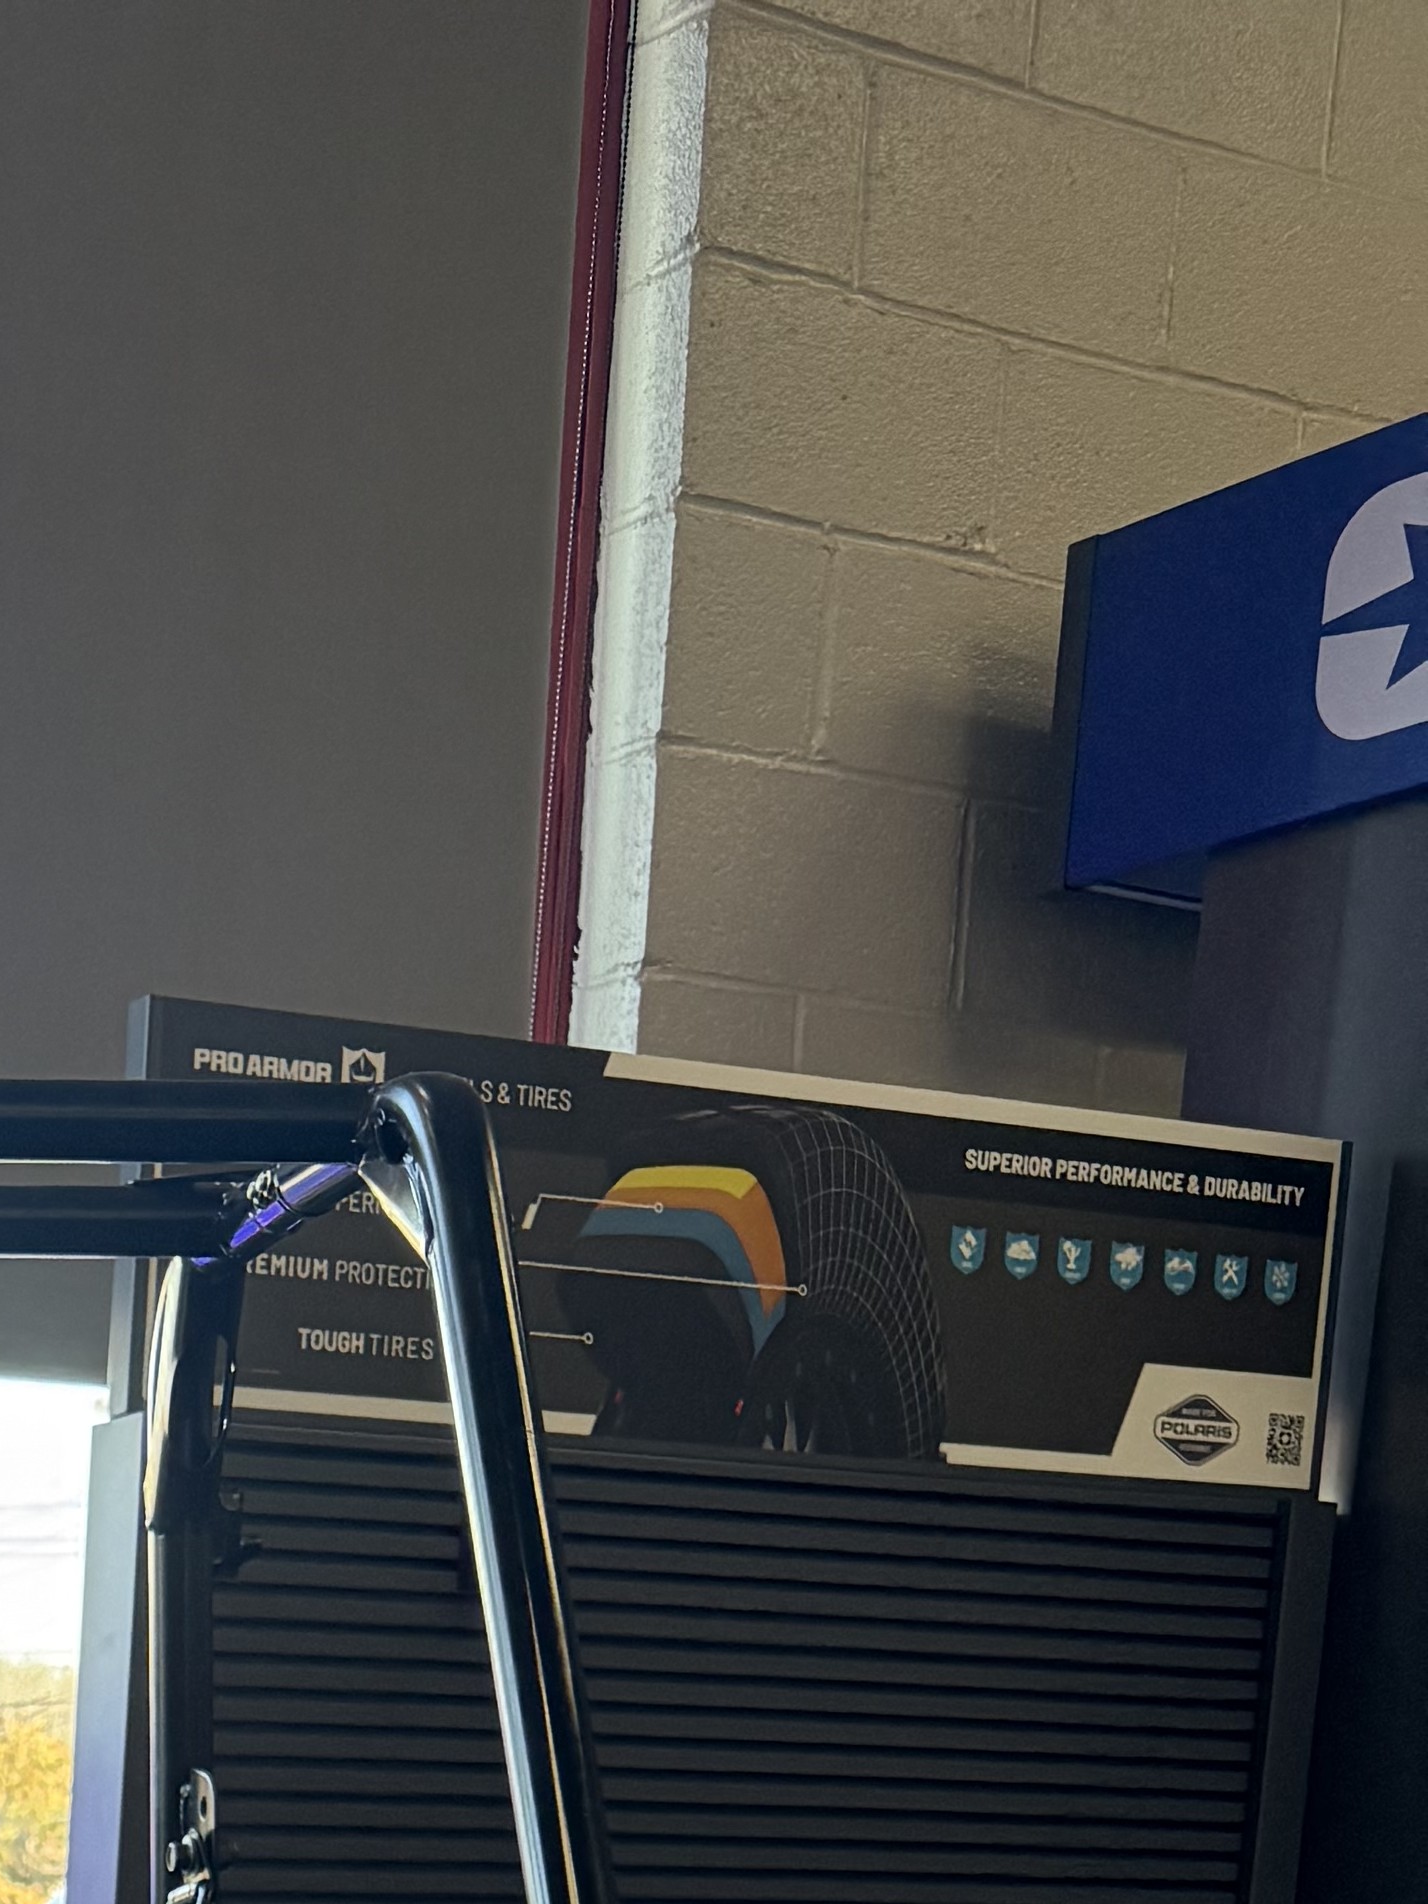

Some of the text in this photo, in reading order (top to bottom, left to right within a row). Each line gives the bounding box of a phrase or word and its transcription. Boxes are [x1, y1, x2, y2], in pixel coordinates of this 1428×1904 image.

[516, 1083, 573, 1113] TIRES
[963, 1148, 1306, 1207] SUPERIOR PERFORMANCE & DURABILITY
[246, 1253, 432, 1290] EMIUM PROTECTI
[297, 1326, 435, 1361] TOUGH TIRES
[1160, 1421, 1233, 1440] POLARIS
